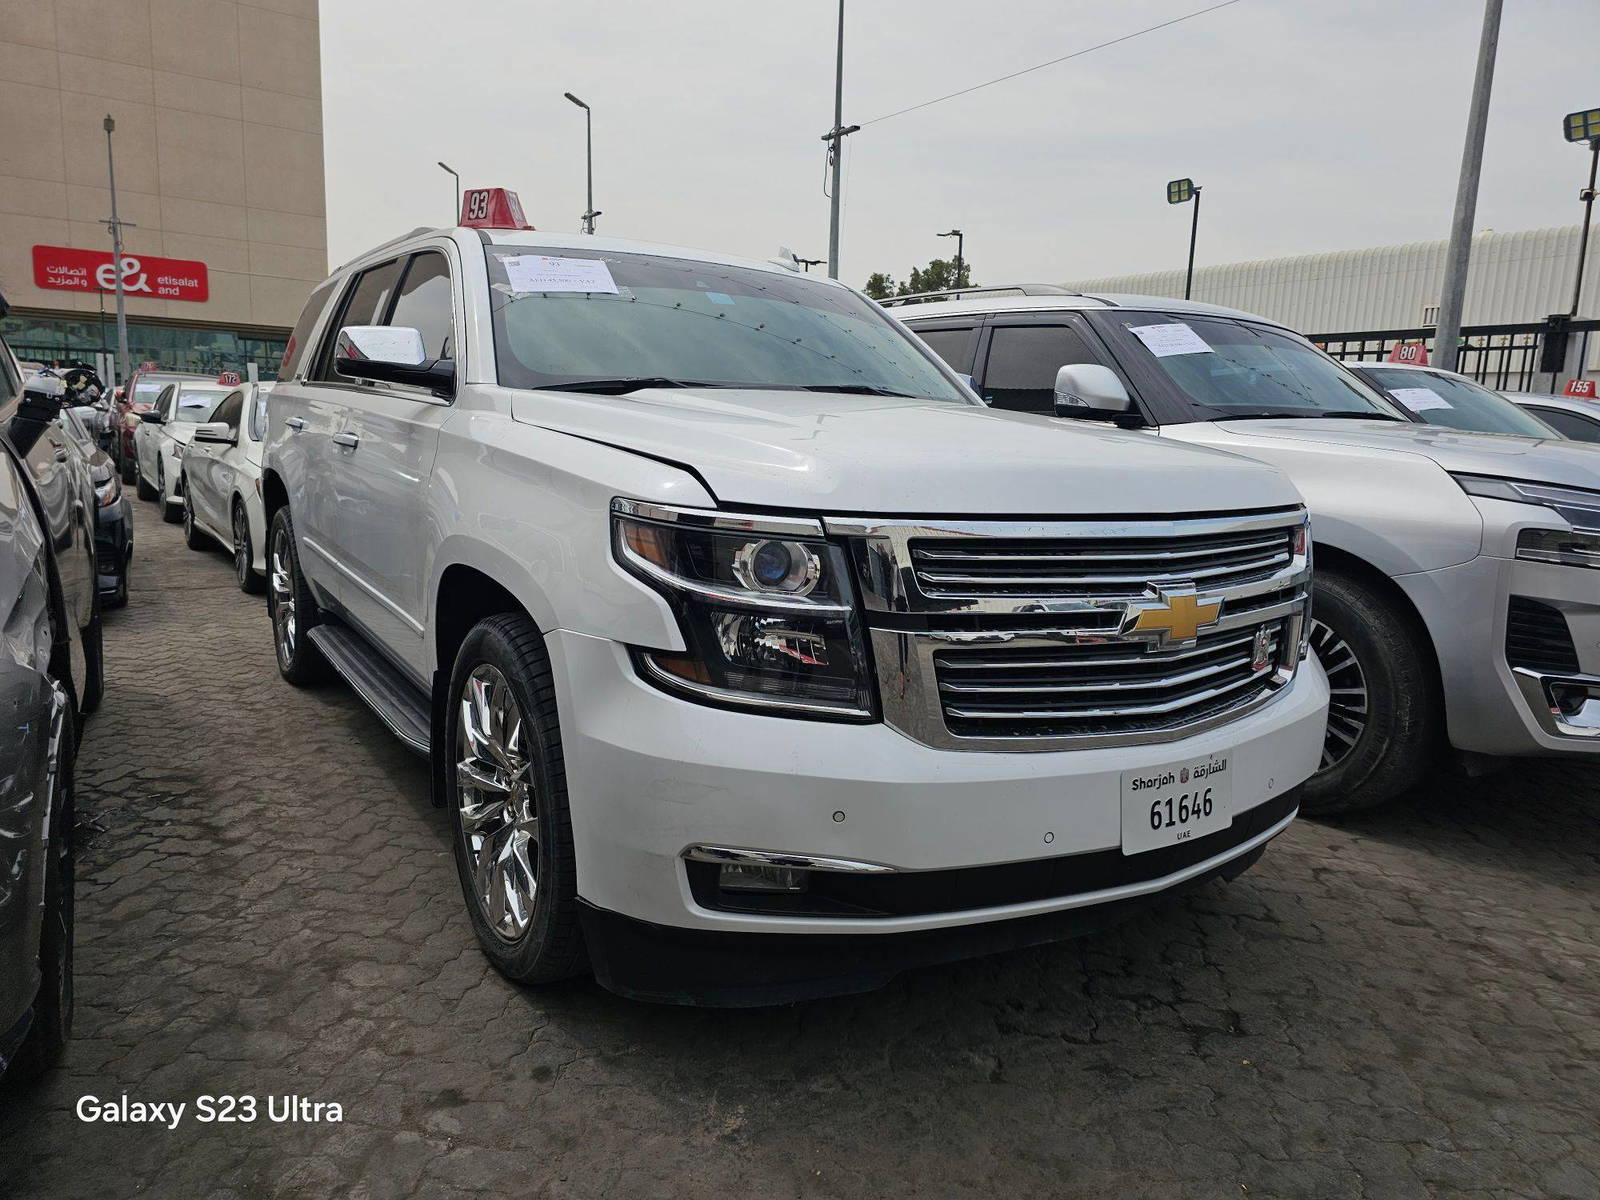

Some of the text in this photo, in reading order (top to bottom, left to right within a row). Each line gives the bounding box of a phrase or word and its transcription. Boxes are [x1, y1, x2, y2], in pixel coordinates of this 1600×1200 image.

[469, 191, 489, 219] 93
[46, 264, 87, 276] اتصالات
[95, 257, 152, 293] e&
[157, 276, 199, 288] etisalat
[158, 286, 180, 296] and
[1399, 345, 1417, 360] 80
[1569, 380, 1591, 393] 155
[1193, 755, 1227, 779] الشارقة
[1131, 771, 1176, 791] Sharjah
[1150, 787, 1213, 830] 61646
[1176, 830, 1192, 840] UAE
